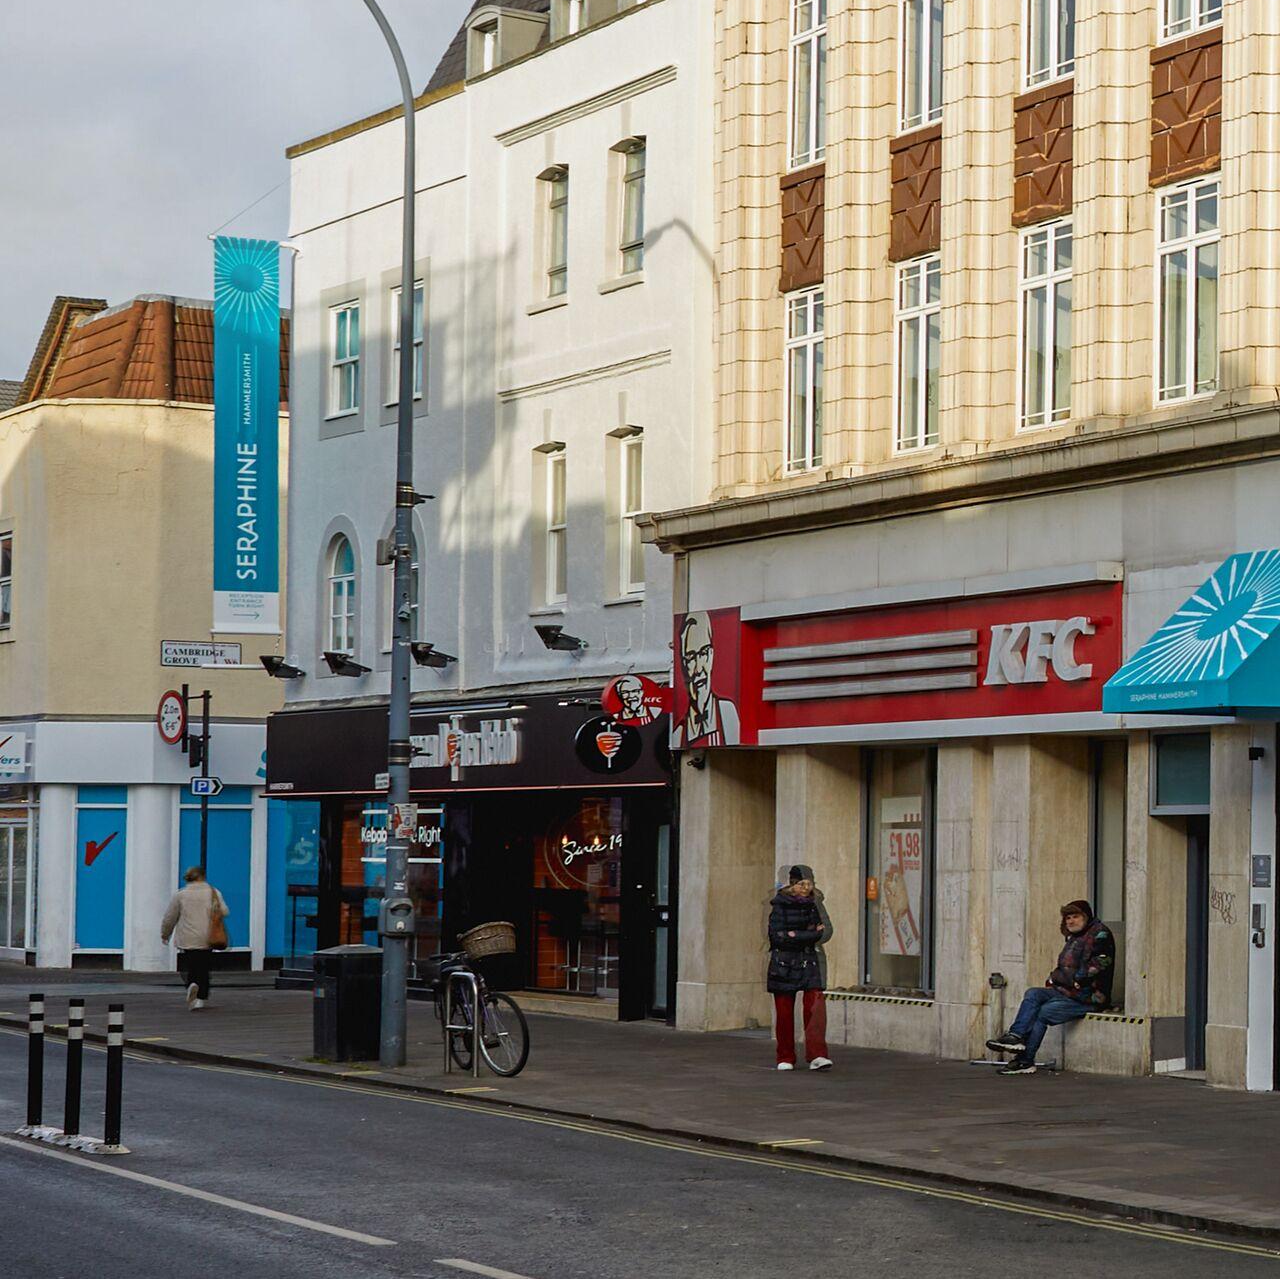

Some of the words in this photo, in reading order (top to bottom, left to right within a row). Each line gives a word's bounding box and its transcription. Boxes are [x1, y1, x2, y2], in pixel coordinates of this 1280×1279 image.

[237, 443, 259, 580] SERAPHINE
[164, 647, 226, 657] CAMBRIDGE
[983, 617, 1095, 685] KFC
[164, 656, 199, 665] GROVE
[1130, 693, 1157, 702] SERAPHINE
[197, 781, 208, 791] P
[361, 826, 387, 843] Kebab
[418, 826, 441, 847] Right
[562, 840, 607, 865] Since
